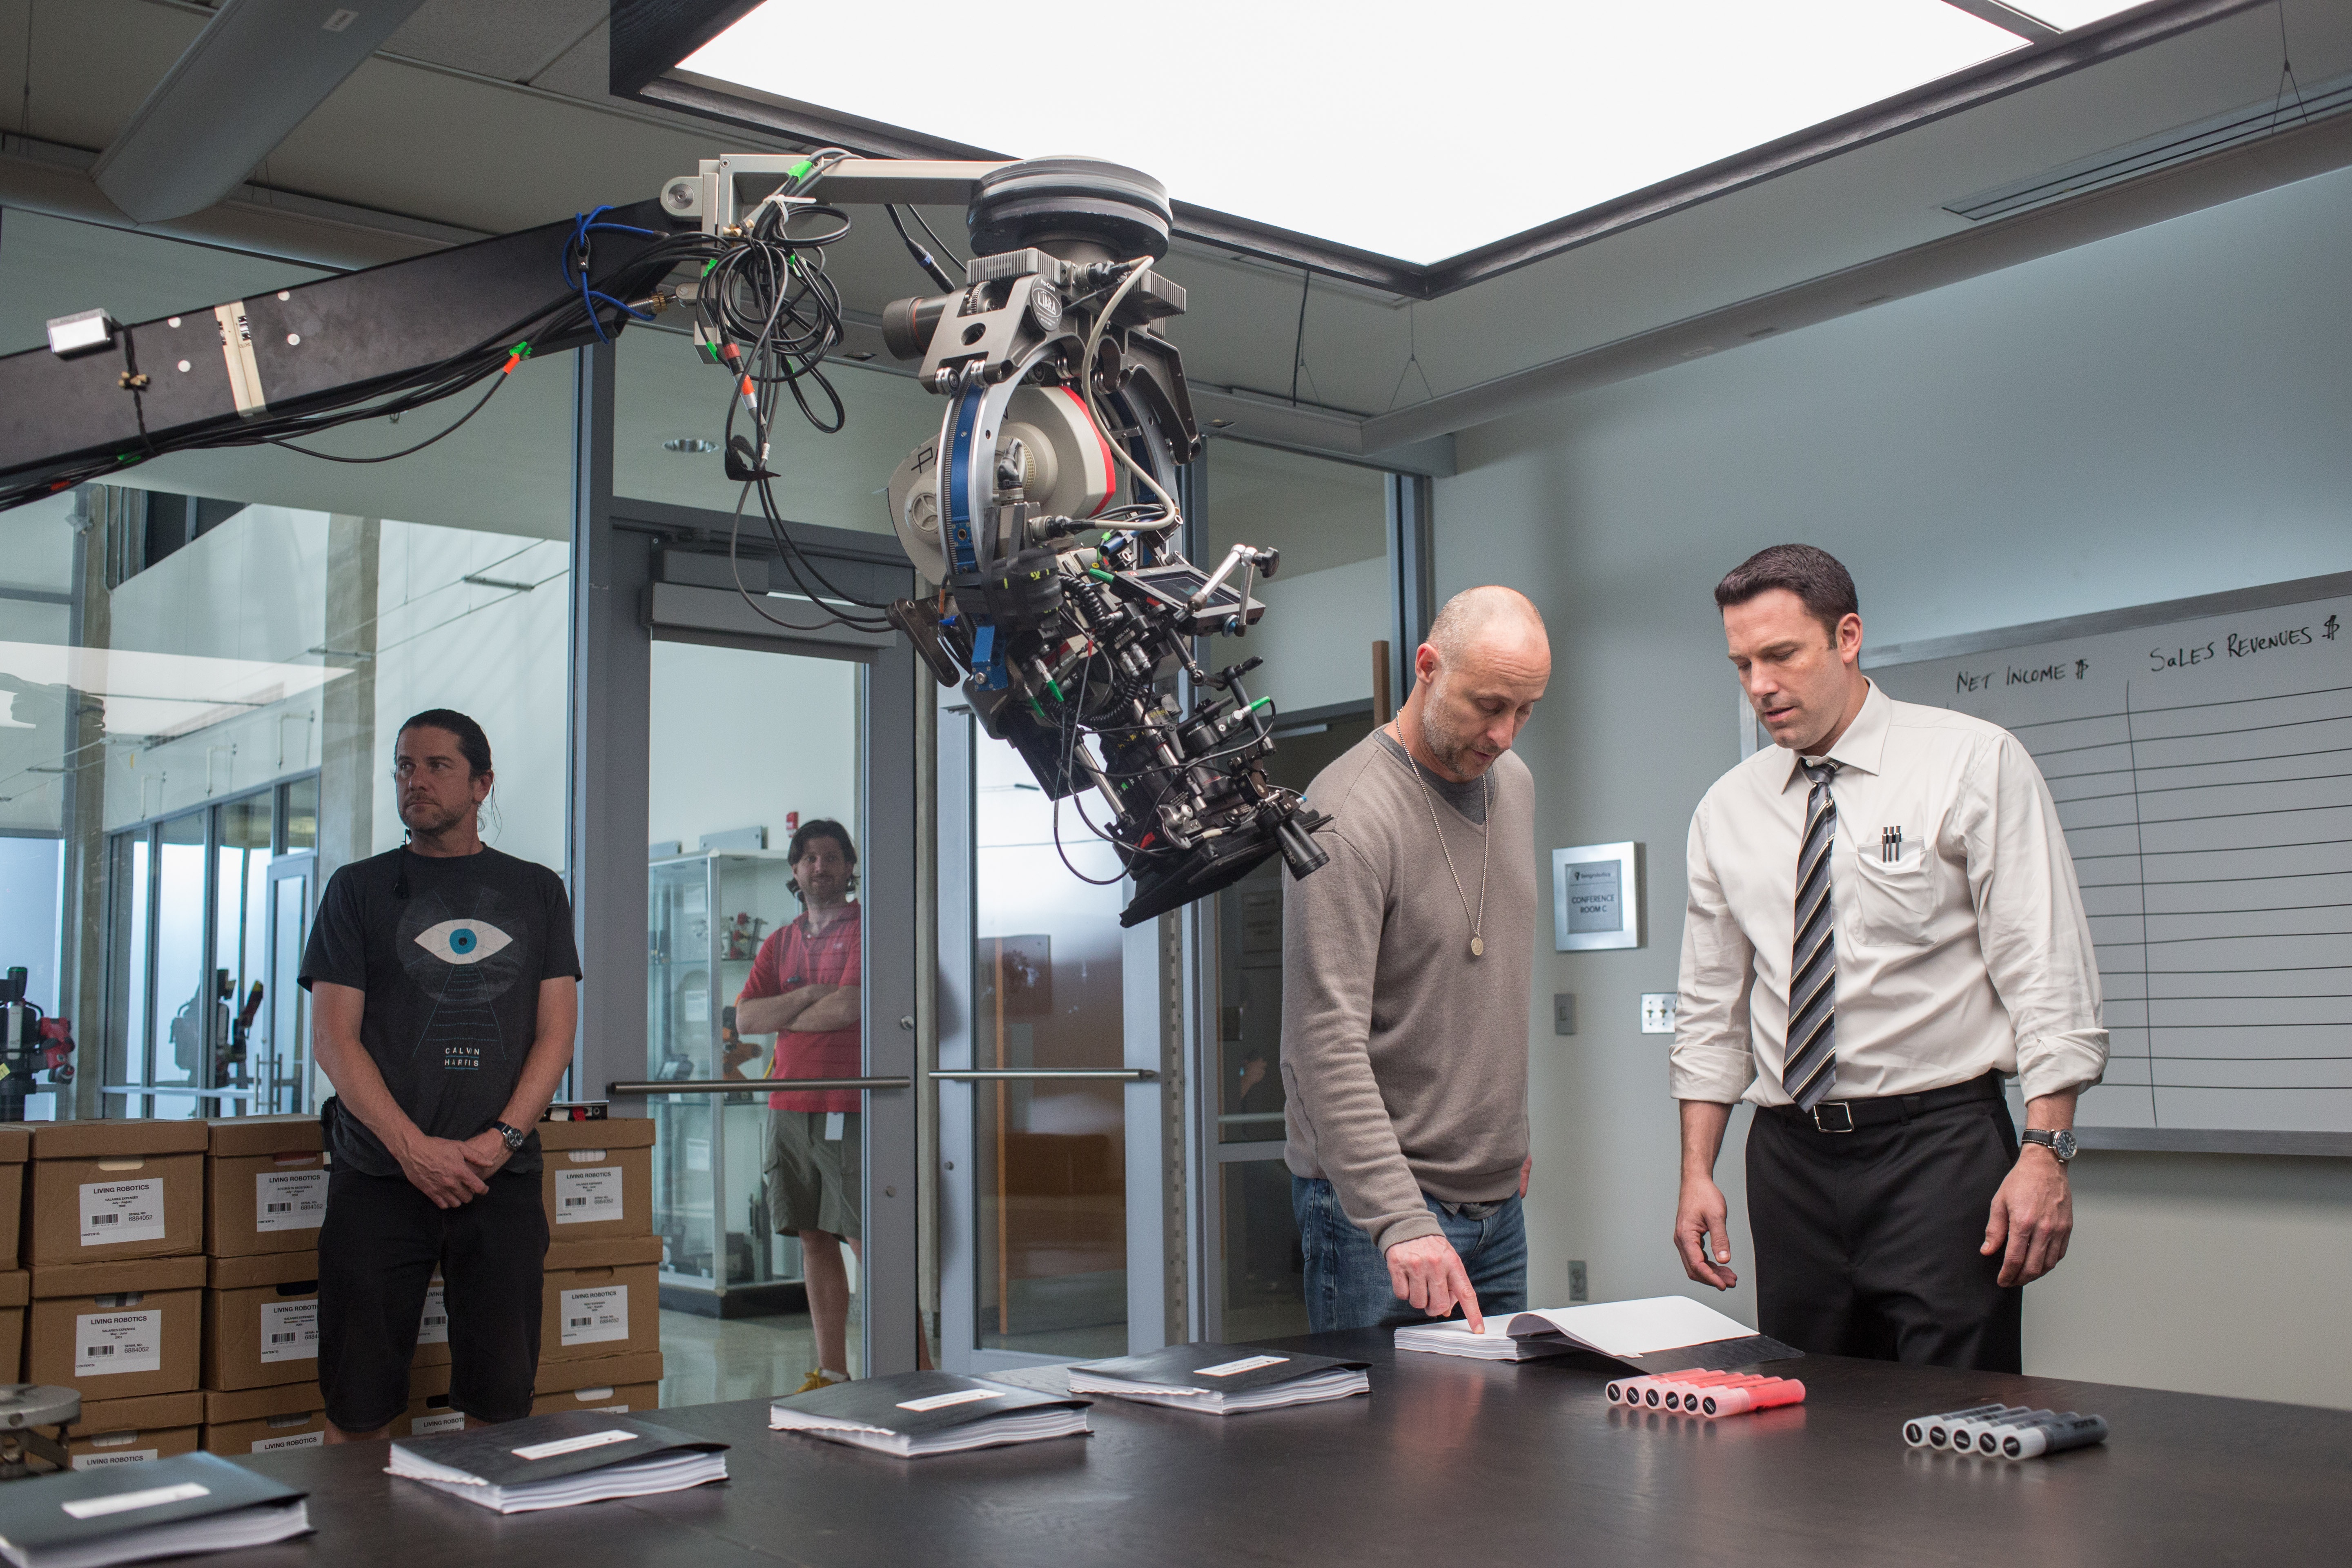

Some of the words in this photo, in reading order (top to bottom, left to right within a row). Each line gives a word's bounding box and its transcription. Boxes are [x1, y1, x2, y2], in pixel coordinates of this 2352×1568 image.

[2322, 615, 2340, 641] $
[1956, 670, 1992, 693] NET
[2006, 665, 2066, 686] INCOME
[2075, 659, 2089, 680] $
[1572, 894, 1614, 904] CONFERENCE
[286, 1437, 317, 1447] ROBOTICS
[110, 1454, 144, 1463] ROBOTICS
